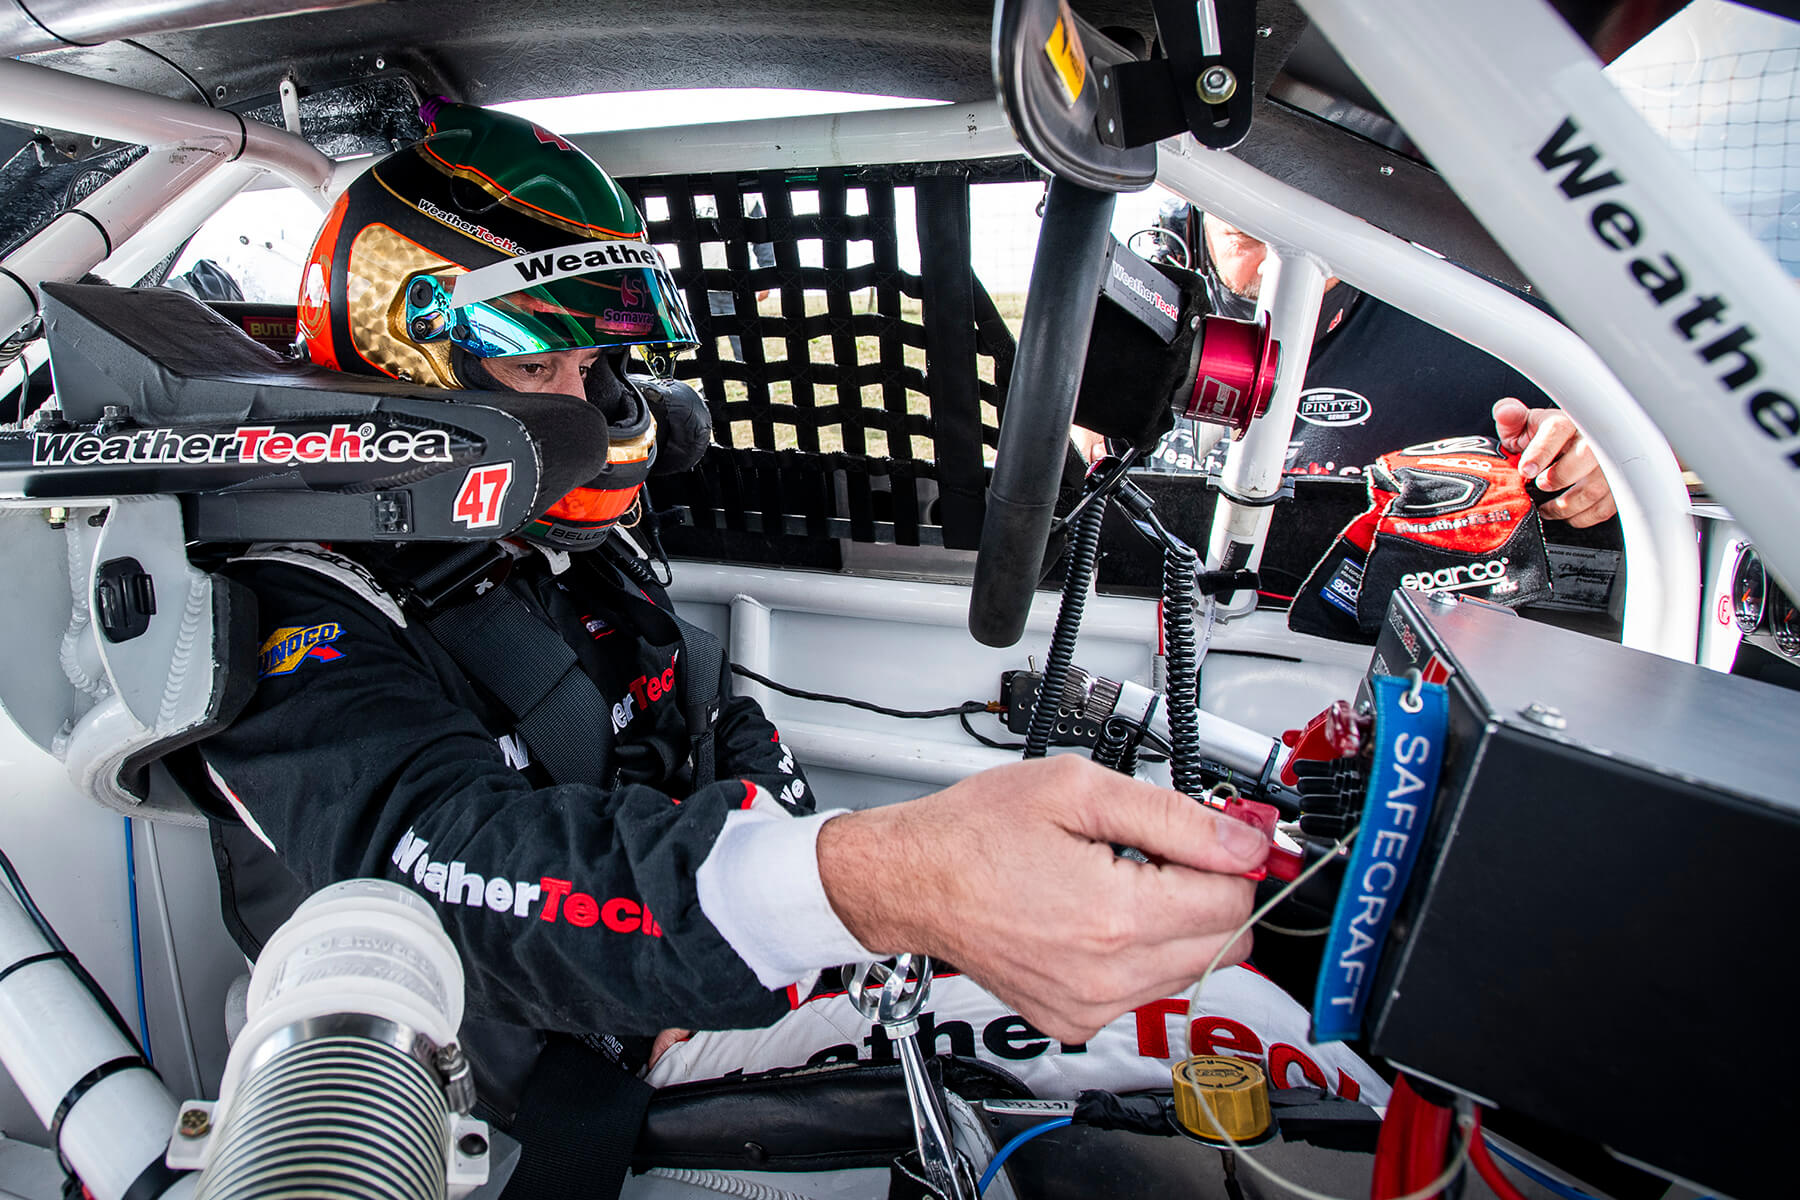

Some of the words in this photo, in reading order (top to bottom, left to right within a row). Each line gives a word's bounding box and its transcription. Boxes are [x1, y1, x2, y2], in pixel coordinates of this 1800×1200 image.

[1305, 401, 1358, 412] PINTY'S
[457, 468, 508, 524] 47
[1400, 559, 1506, 593] sparco
[1331, 732, 1430, 1014] SAFECRAFT
